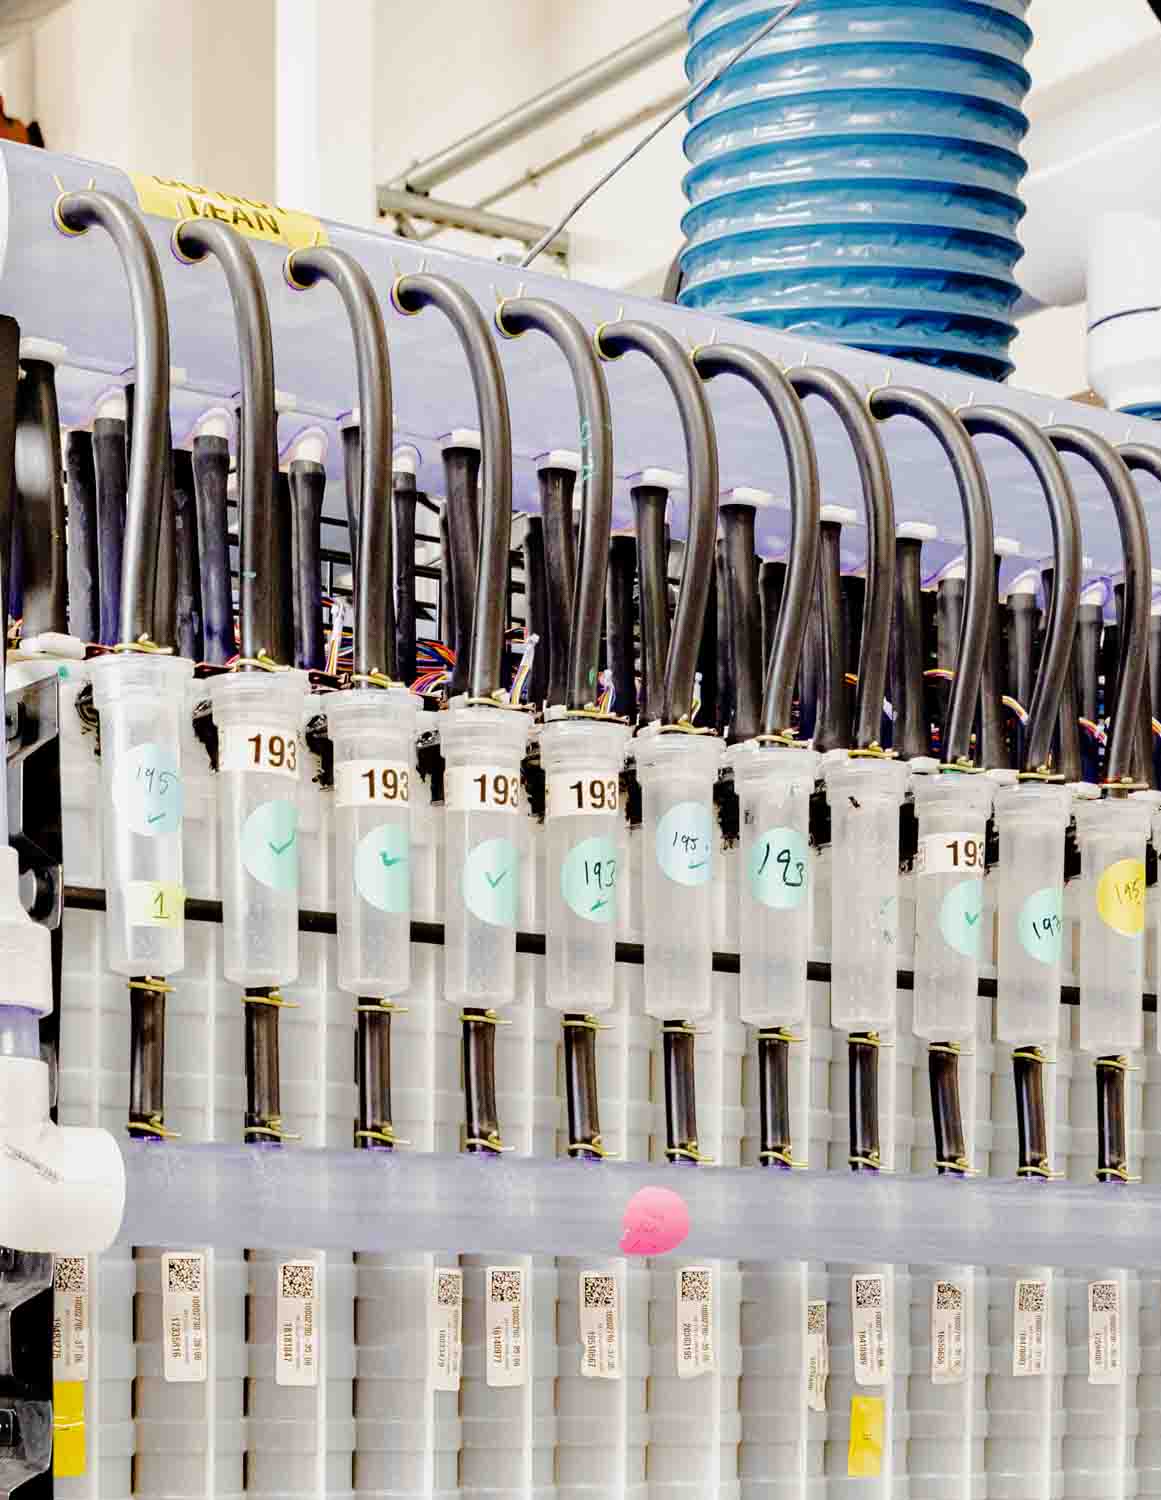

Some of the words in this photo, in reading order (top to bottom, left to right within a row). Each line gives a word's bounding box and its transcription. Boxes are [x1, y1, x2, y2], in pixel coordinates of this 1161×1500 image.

[247, 733, 297, 771] 193
[361, 767, 409, 802] 193
[472, 773, 520, 808] 193
[570, 779, 617, 810] 193
